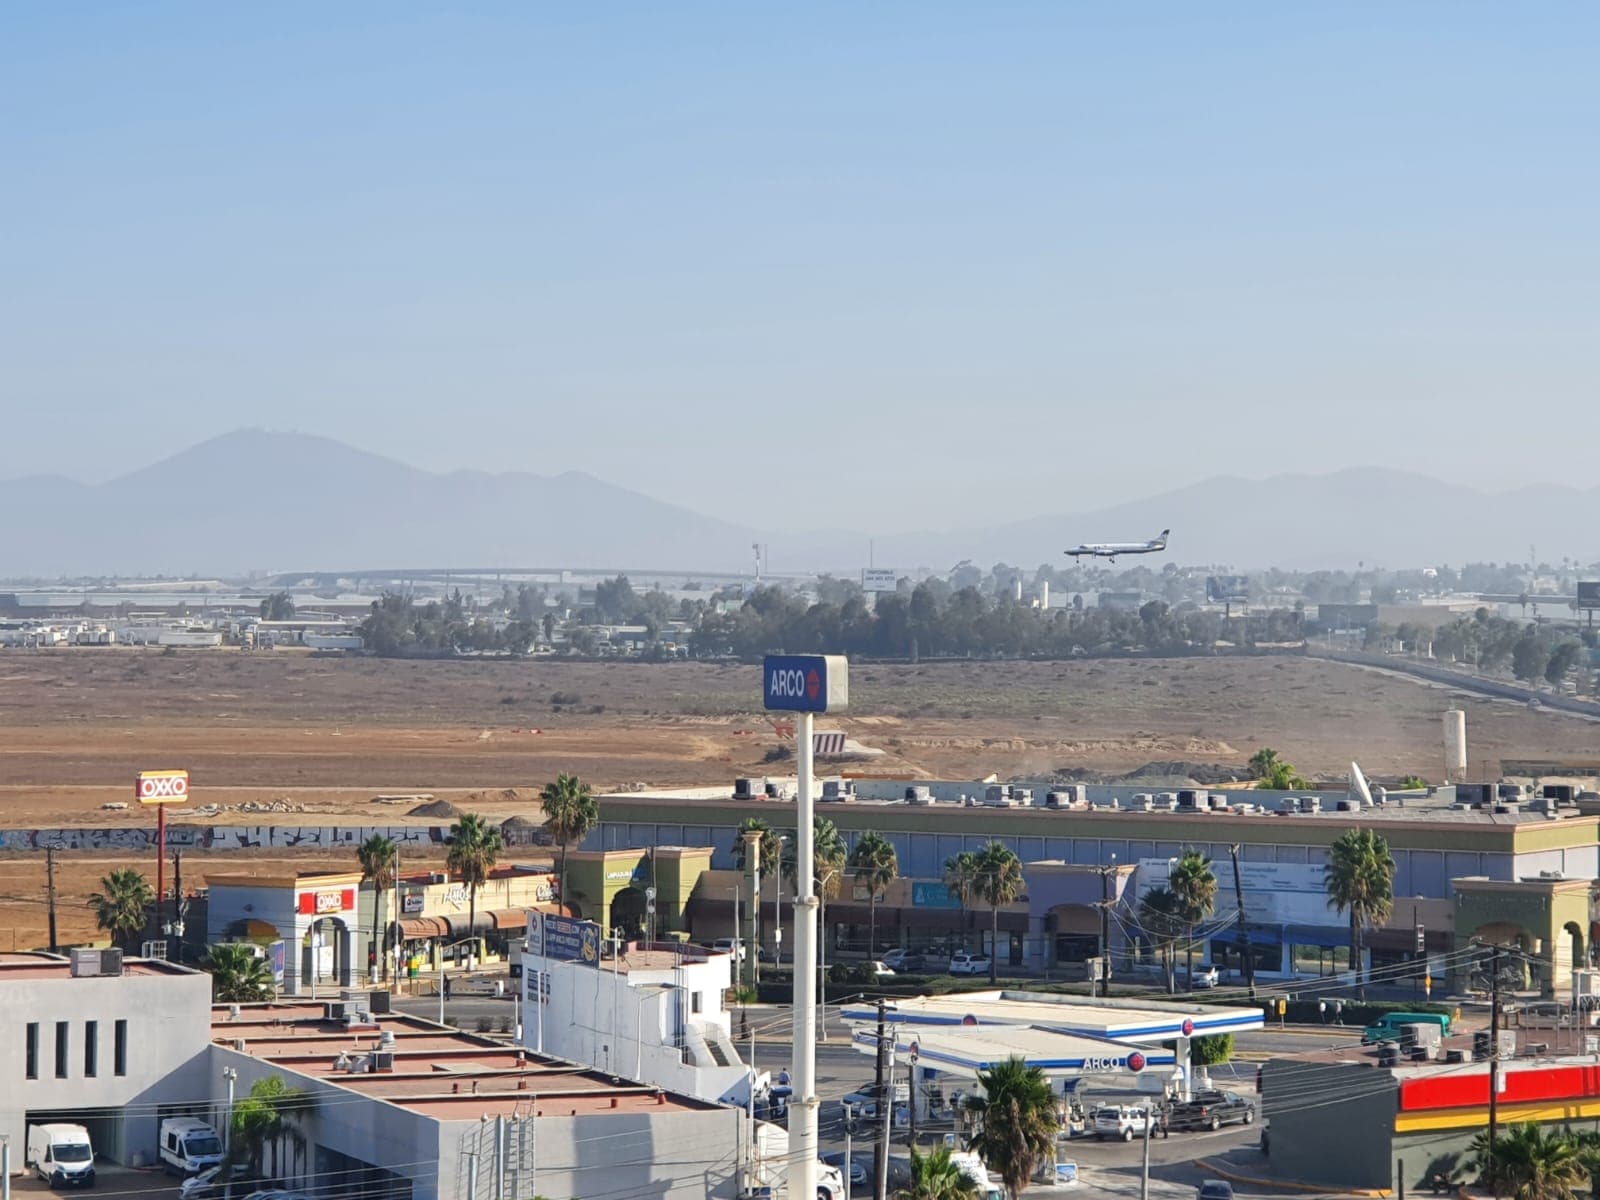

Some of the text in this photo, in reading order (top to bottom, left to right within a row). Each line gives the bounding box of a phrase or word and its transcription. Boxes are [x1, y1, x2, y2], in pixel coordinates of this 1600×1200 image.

[770, 669, 805, 697] ARCO
[141, 777, 186, 797] OXXO
[317, 894, 342, 909] OXXO
[1083, 1057, 1120, 1071] ARCO
